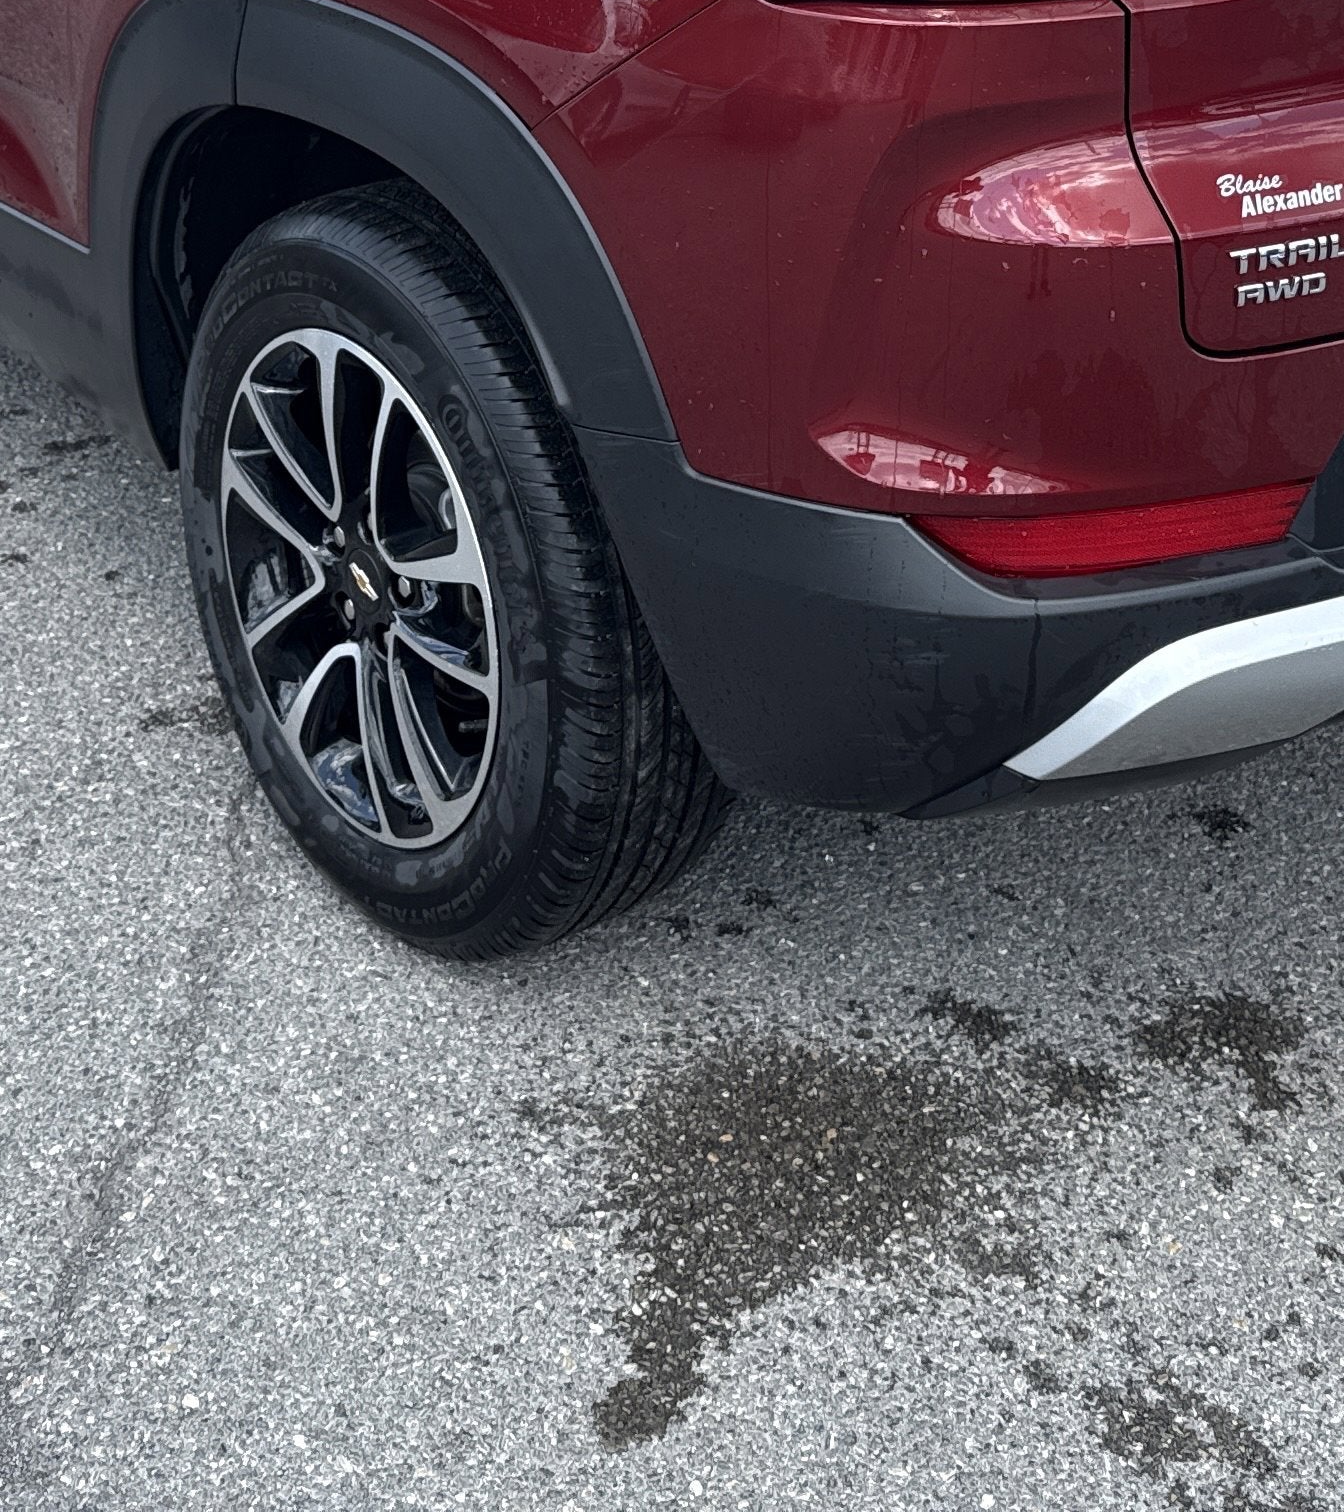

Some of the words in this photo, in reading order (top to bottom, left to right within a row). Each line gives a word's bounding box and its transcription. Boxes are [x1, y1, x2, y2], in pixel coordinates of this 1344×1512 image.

[1216, 173, 1283, 198] Blaise
[1241, 182, 1344, 218] Alexander
[1235, 271, 1327, 308] AWD
